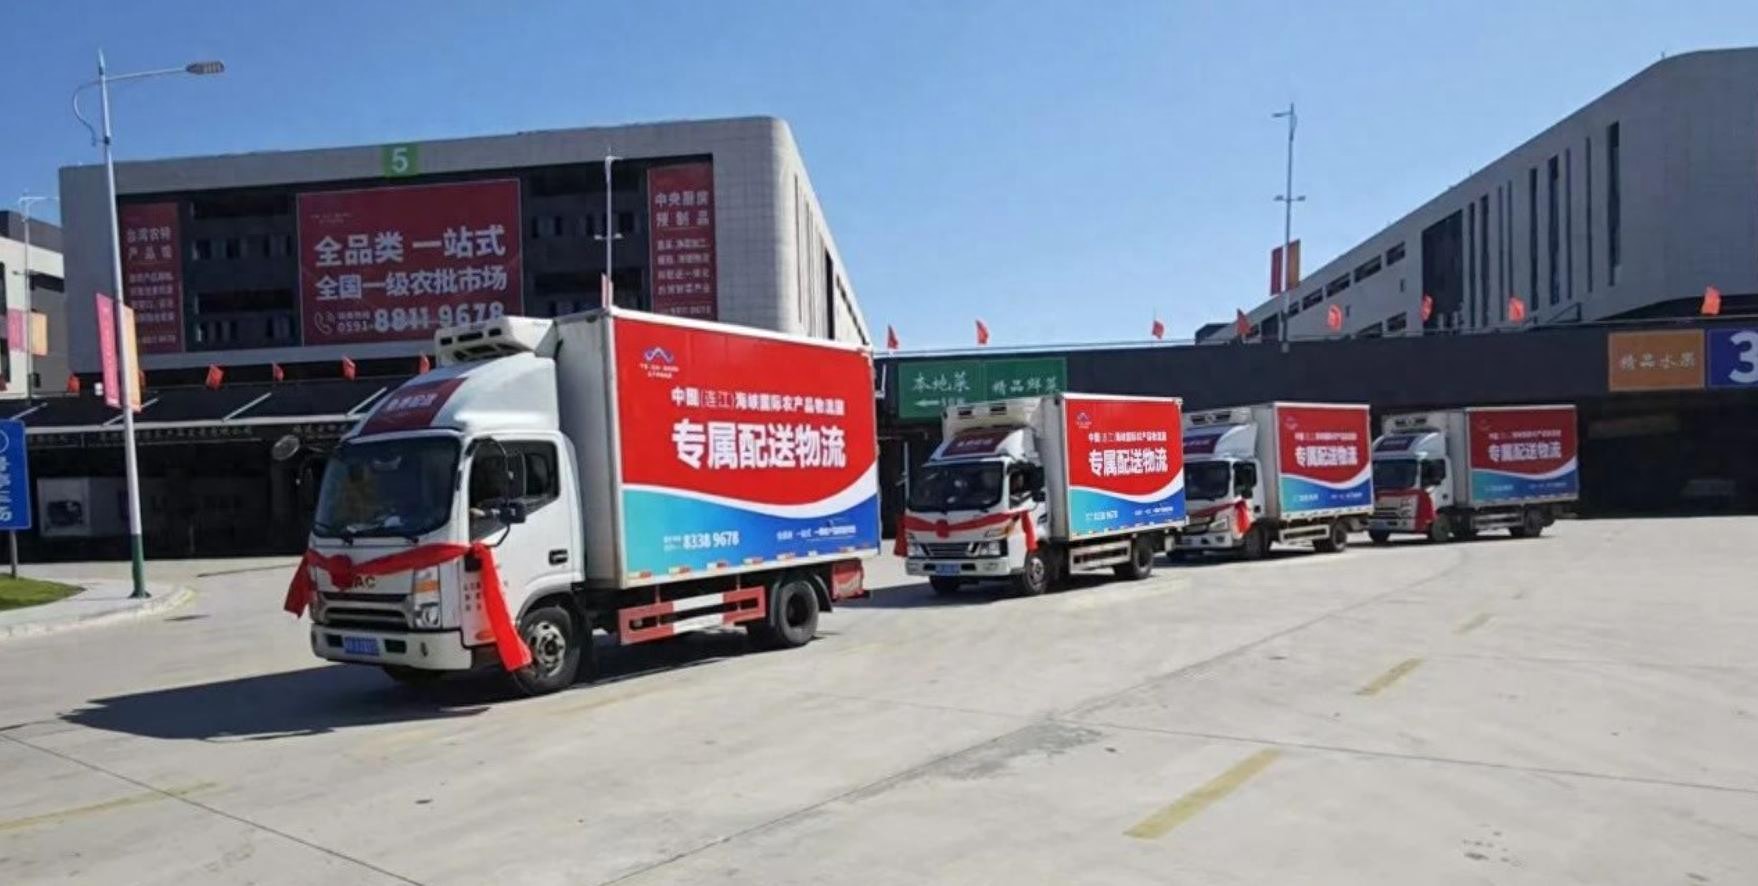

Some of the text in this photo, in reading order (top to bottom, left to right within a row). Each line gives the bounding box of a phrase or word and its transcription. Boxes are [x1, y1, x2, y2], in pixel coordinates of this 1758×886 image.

[391, 147, 409, 173] 5
[655, 190, 709, 208] 中央厨房
[656, 209, 710, 227] 预制品
[314, 224, 506, 267] 全品类 一站式
[315, 265, 507, 301] 全国一级农批市场
[374, 306, 429, 333] 8811
[438, 301, 504, 329] 9678
[1621, 352, 1696, 370] 精品水果
[1728, 331, 1758, 383] 3
[912, 371, 971, 393] 本地菜
[672, 418, 847, 469] 专属配送物流
[1088, 447, 1169, 477] 专属配送物流
[1294, 446, 1358, 468] 专属配送物流
[682, 532, 712, 549] 8338
[712, 530, 740, 547] 9678
[350, 575, 376, 588] AC
